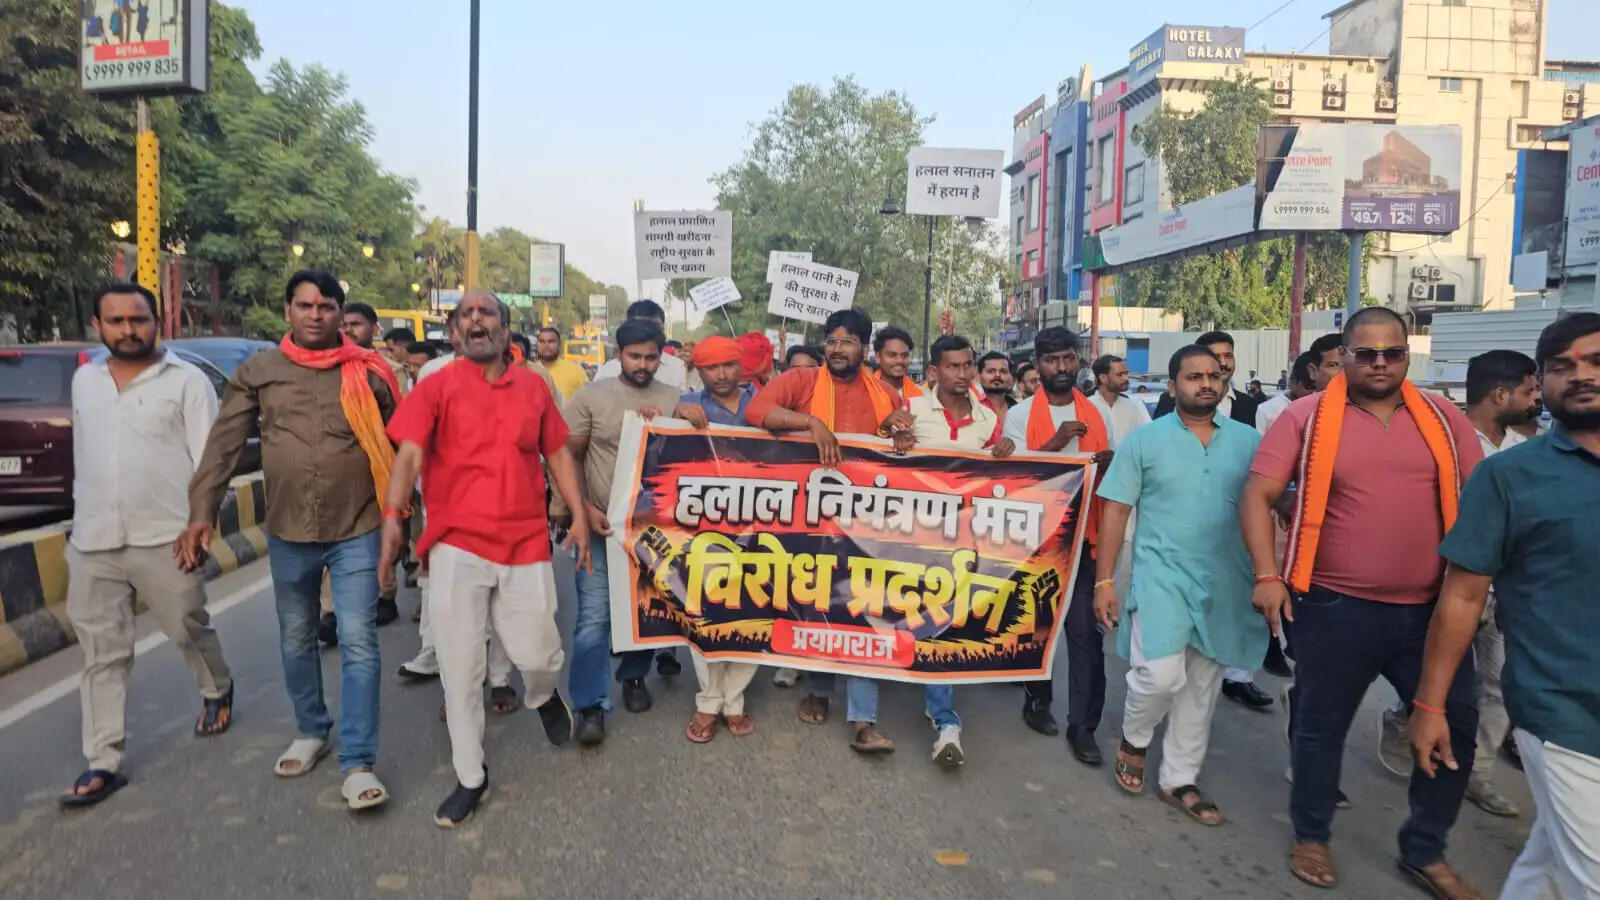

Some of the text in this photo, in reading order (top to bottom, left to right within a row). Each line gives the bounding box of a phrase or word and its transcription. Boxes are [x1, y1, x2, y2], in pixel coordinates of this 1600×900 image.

[1169, 28, 1212, 43] HOTEL
[1187, 46, 1242, 60] GALAXY
[93, 58, 179, 78] 9999 999 835
[915, 165, 995, 179] हलाल सनातन
[927, 182, 980, 200] में हराम है
[781, 263, 810, 277] हलाल
[836, 273, 852, 289] देश
[785, 280, 799, 293] की
[784, 297, 804, 313] लिए
[675, 467, 1045, 551] हलाल नियंत्रण मंच
[684, 530, 1018, 633] विरोध प्रदर्शन
[791, 626, 896, 660] प्रयागराज
